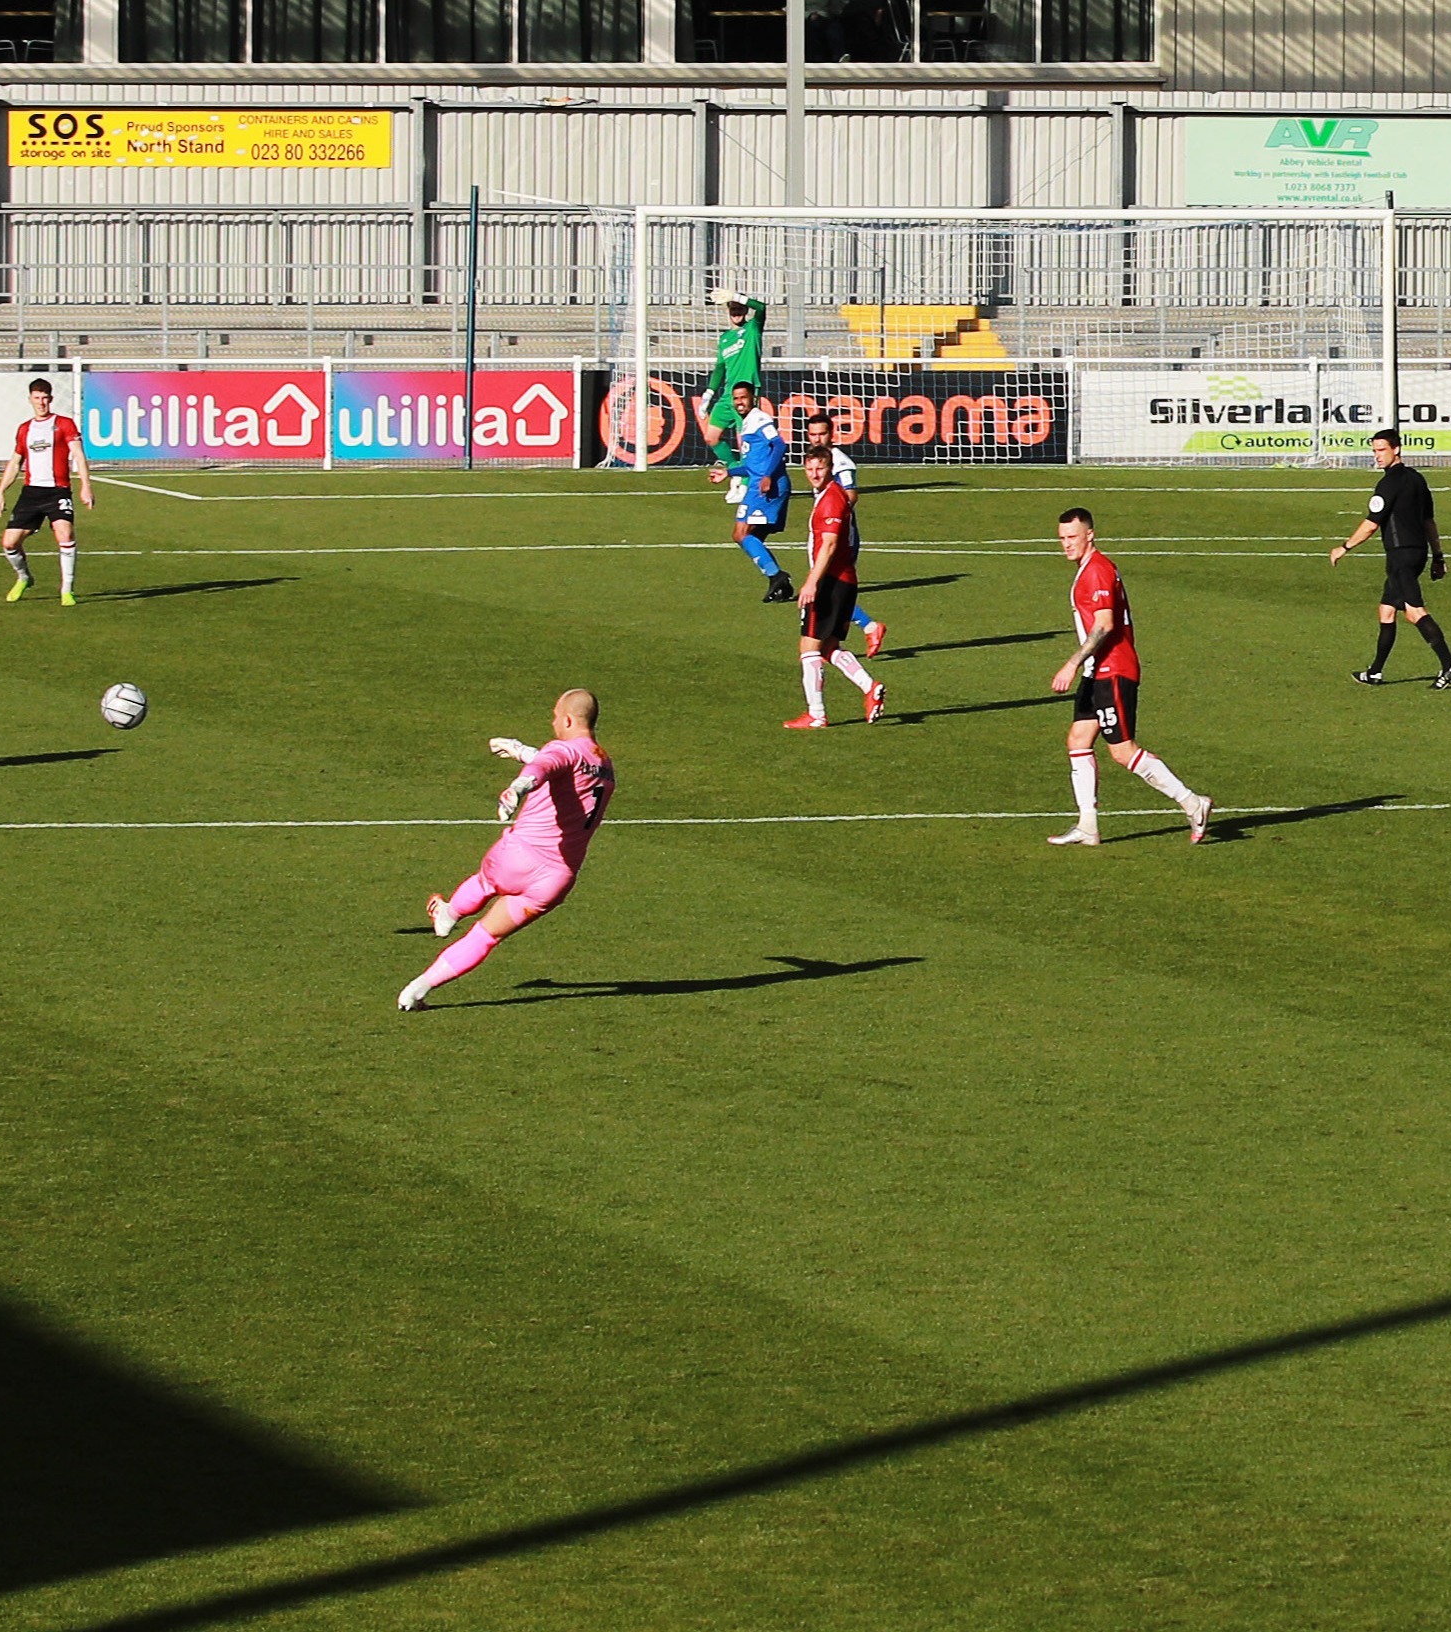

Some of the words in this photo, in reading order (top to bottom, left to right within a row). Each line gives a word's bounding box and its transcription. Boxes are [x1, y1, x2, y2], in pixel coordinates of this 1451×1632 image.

[28, 113, 105, 139] SOS
[126, 121, 162, 133] Proud
[164, 121, 225, 135] Sponsors
[238, 115, 306, 125] CONTAINERS
[311, 115, 336, 125] AND
[338, 115, 379, 125] CAINS
[263, 129, 287, 139] HIRE
[291, 129, 315, 139] AND
[318, 129, 353, 139] SALES
[1264, 119, 1379, 148] AVR
[126, 139, 172, 153] North
[177, 139, 225, 153] Stand
[251, 144, 279, 160] 023
[283, 144, 303, 160] 80
[308, 144, 365, 160] 332266
[20, 149, 65, 161] storage
[71, 149, 87, 158] on
[92, 148, 112, 158] site
[88, 395, 261, 447] utilita
[338, 395, 510, 447] utilita
[1245, 431, 1353, 448] automotive
[1360, 431, 1435, 451] reling
